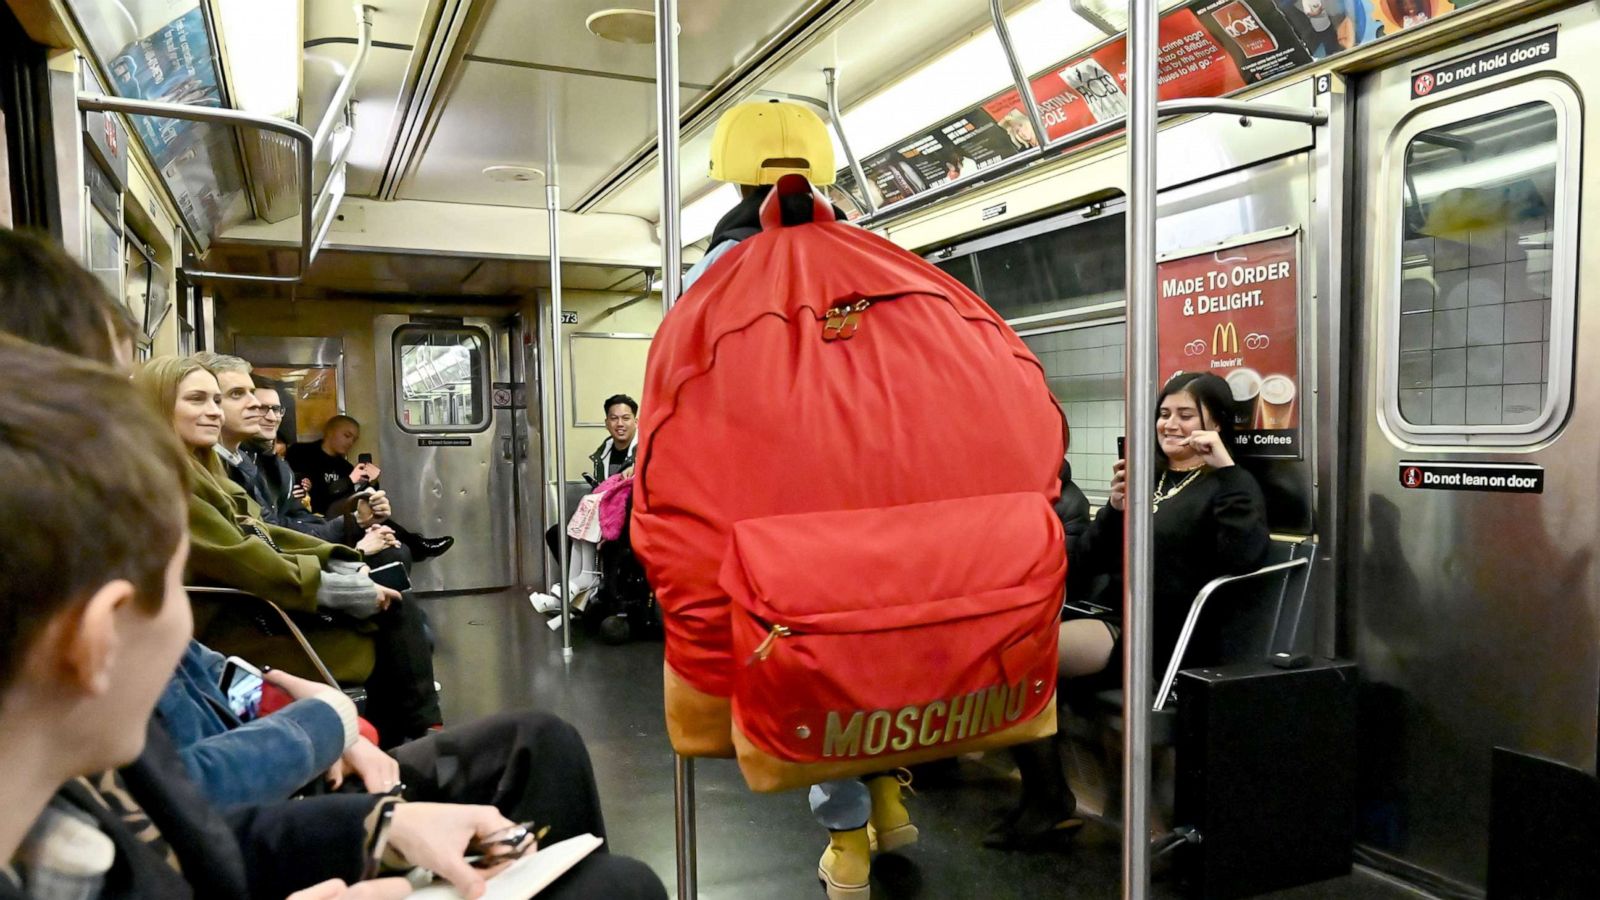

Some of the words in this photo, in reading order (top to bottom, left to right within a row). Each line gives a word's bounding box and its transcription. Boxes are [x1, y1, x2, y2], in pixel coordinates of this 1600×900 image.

[1162, 38, 1184, 52] crime
[1184, 30, 1205, 43] saga
[1177, 48, 1186, 56] of
[1184, 39, 1212, 53] Britain,
[1170, 60, 1182, 68] by
[1181, 54, 1196, 64] the
[1194, 44, 1218, 58] throat
[1436, 71, 1453, 86] Do
[1455, 64, 1476, 80] not
[1478, 53, 1507, 74] hold
[1509, 41, 1550, 64] doors
[1158, 71, 1180, 85] efuses
[1177, 66, 1188, 76] to
[1187, 61, 1199, 73] let
[1317, 77, 1328, 92] 6
[1036, 91, 1079, 116] ARTINA
[1183, 298, 1194, 316] &
[1253, 434, 1293, 445] Coffees
[1423, 471, 1441, 484] Do
[1441, 473, 1460, 485] not
[1462, 472, 1488, 486] lean
[1489, 475, 1505, 487] on
[1507, 474, 1537, 488] door
[822, 674, 1028, 757] MOSCHINO
